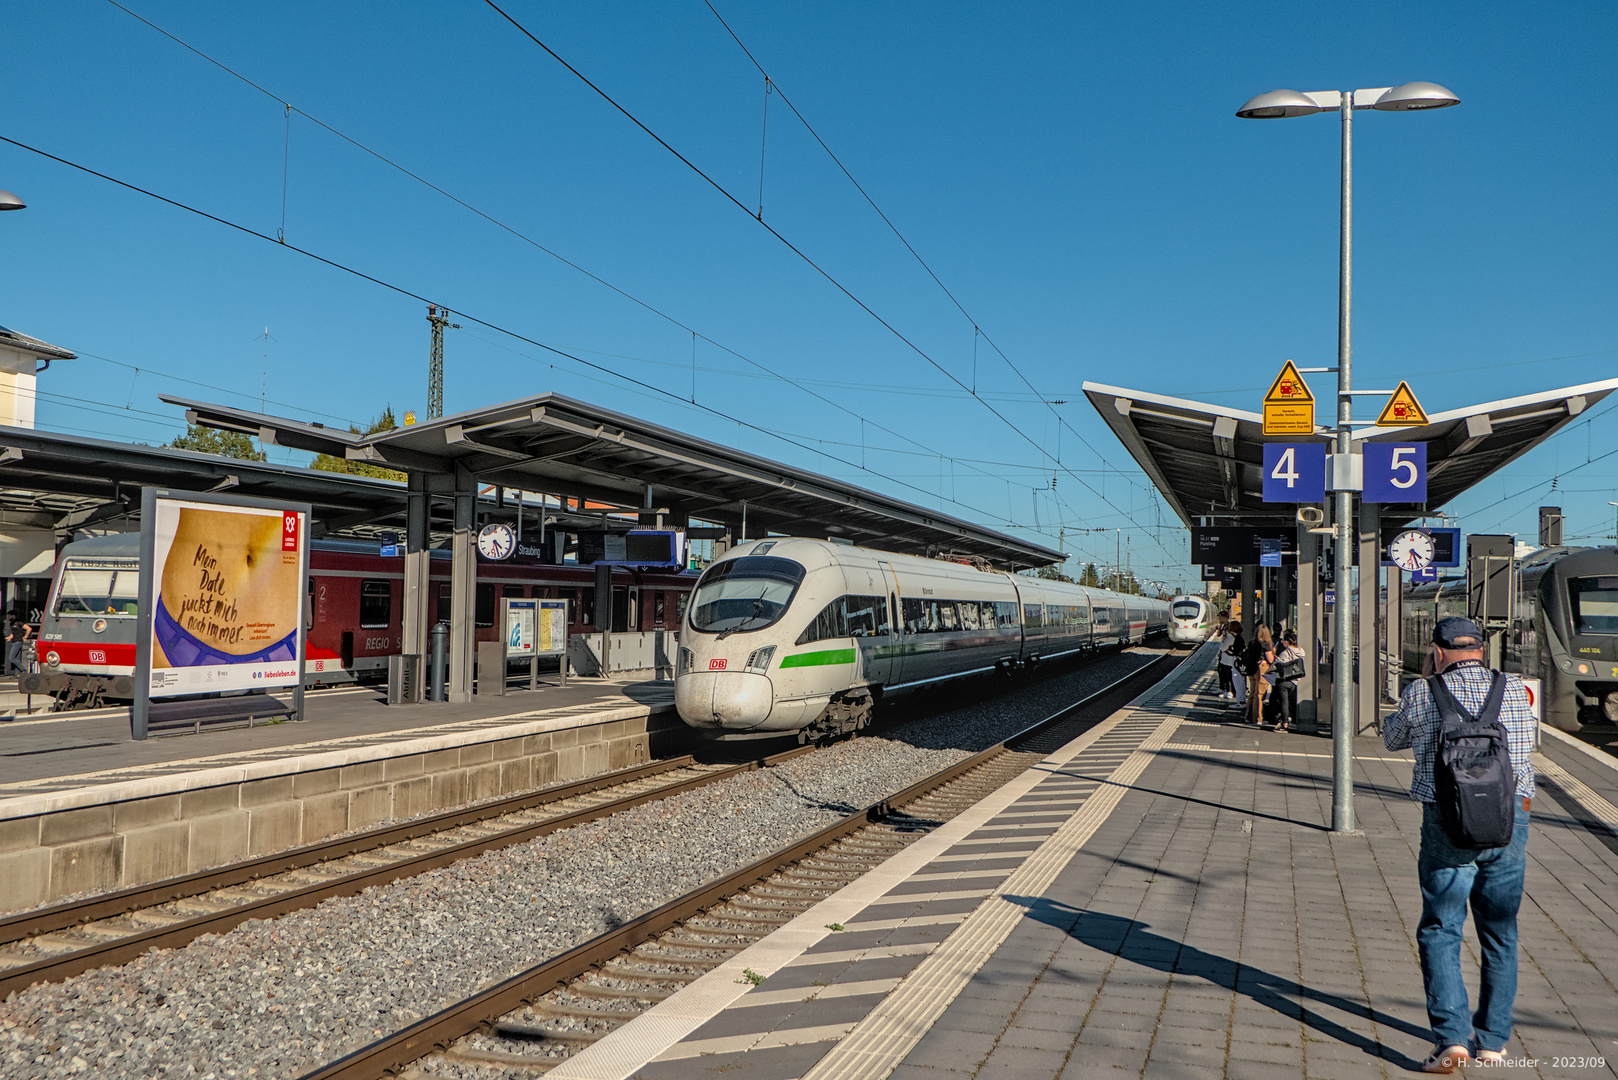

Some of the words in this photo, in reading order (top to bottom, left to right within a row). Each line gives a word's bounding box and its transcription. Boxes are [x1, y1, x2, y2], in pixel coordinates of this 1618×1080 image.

[1272, 448, 1299, 488] 4
[1390, 448, 1418, 488] 5
[194, 544, 217, 570] Mein
[519, 544, 540, 558] Straubing
[200, 569, 225, 596] Date
[320, 586, 326, 600] 2
[177, 592, 214, 626] juckt
[214, 598, 238, 622] mich
[188, 616, 206, 634] noch
[206, 617, 244, 644] immer.
[366, 638, 389, 650] REGIO
[91, 652, 104, 661] DB
[316, 662, 324, 670] DB
[711, 660, 725, 668] DB
[264, 670, 296, 678] liebesleben.de
